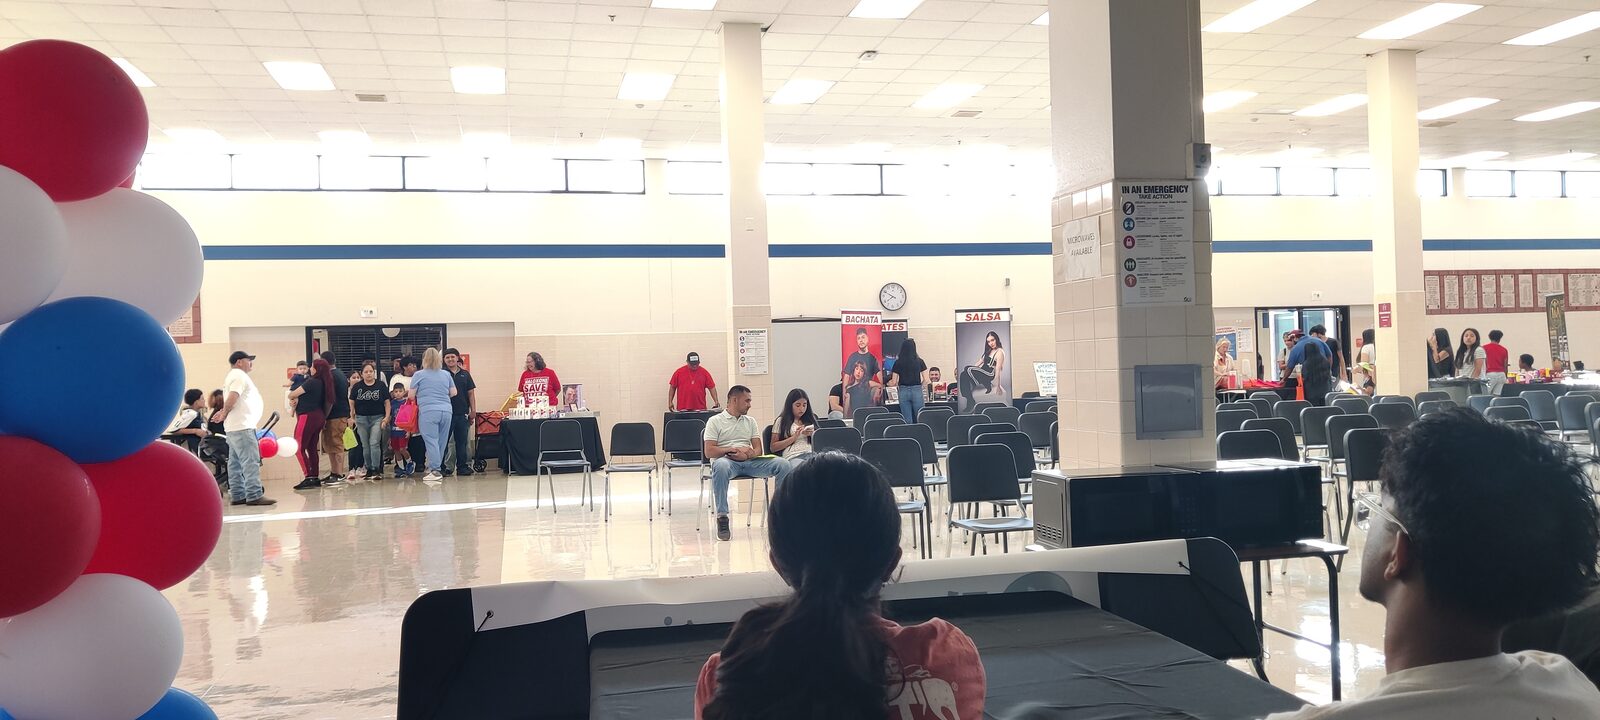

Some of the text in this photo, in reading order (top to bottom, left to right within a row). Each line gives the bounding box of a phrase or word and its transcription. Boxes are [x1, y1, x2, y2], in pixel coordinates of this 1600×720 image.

[1122, 185, 1188, 194] IN AN EMERGENCY
[1066, 232, 1096, 244] MICROWAVES
[1071, 246, 1092, 256] AVAILABLE
[846, 316, 878, 324] BACHATA
[964, 312, 1002, 322] SALSA
[524, 384, 546, 392] SAVE
[357, 388, 380, 400] Lee
